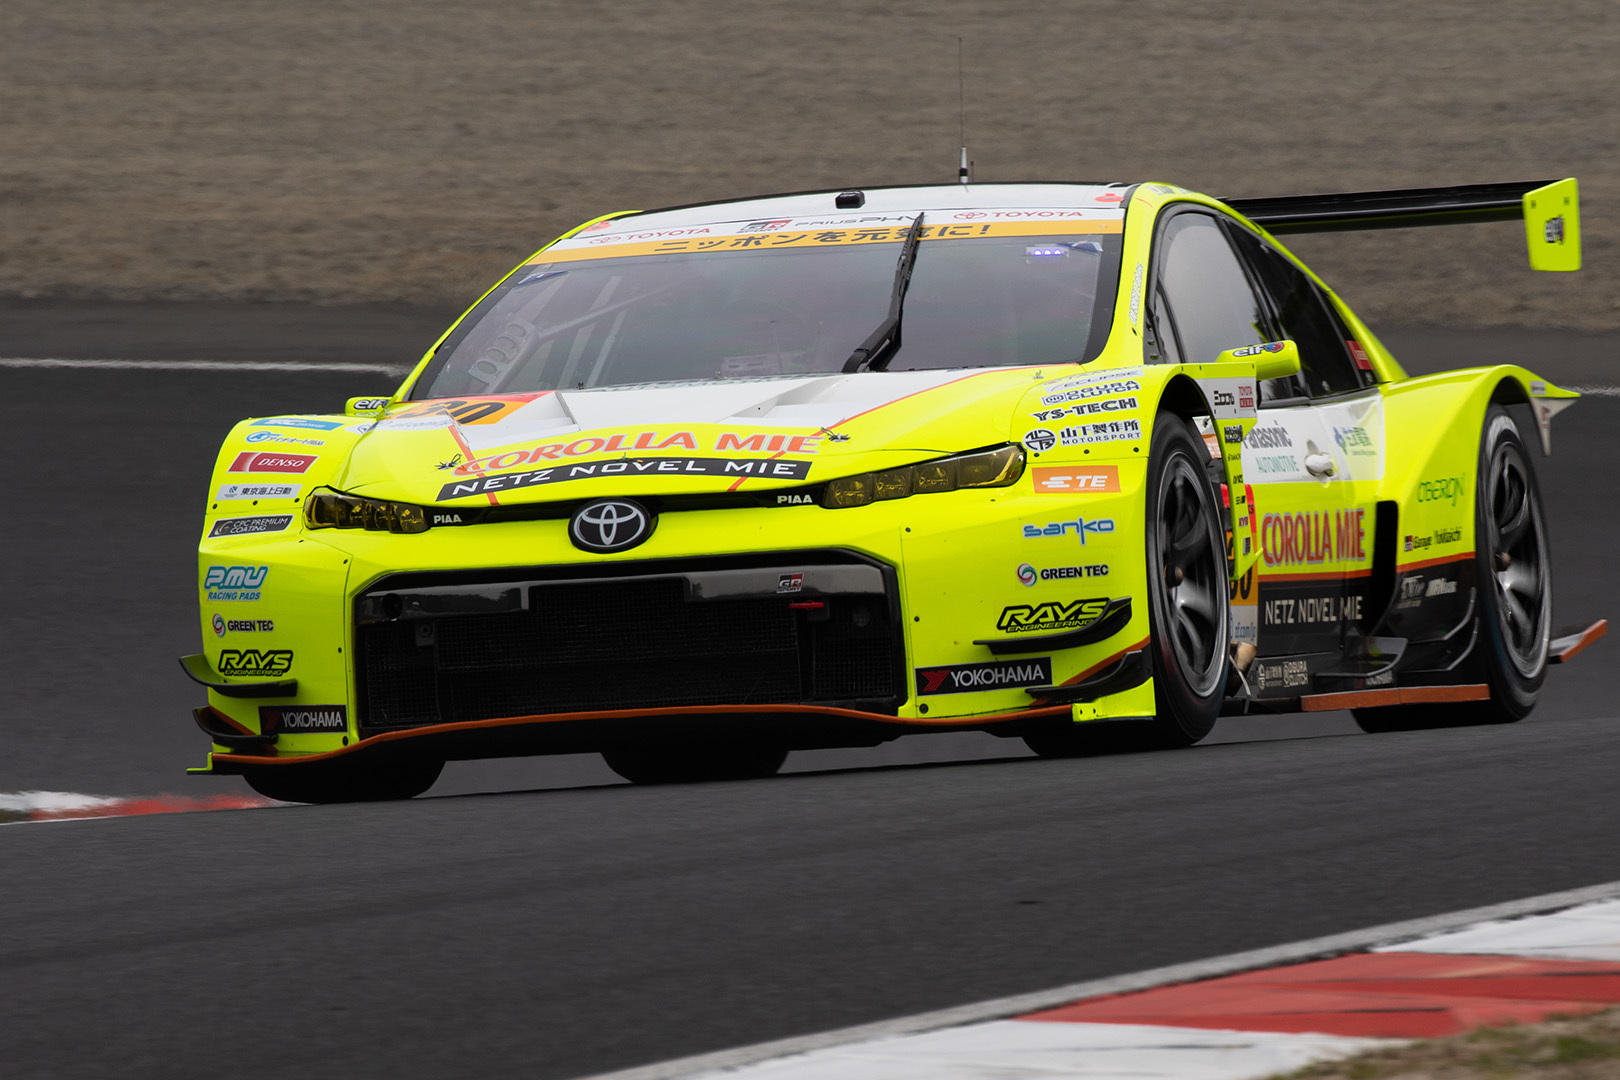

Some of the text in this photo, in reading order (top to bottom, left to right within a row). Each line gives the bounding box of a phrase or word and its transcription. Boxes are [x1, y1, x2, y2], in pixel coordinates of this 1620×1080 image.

[992, 209, 1083, 219] TOYOTA
[627, 226, 711, 241] TOYOTA
[1066, 379, 1138, 396] OGURA
[1067, 384, 1141, 401] CLUTCH
[1032, 397, 1138, 423] YS-TECH
[1062, 432, 1142, 446] MOTORSPORT
[452, 432, 826, 478] COROLLA MIE
[257, 458, 305, 468] DENSO
[452, 460, 798, 496] NETZ NOVEL MIE
[1076, 475, 1108, 488] TE
[777, 494, 814, 505] PIAA
[250, 517, 289, 527] PREMIUM
[433, 513, 463, 525] PIAA
[230, 524, 267, 534] COATING
[1262, 508, 1366, 567] COROLLA MIE
[1040, 564, 1110, 581] GREEN TEC
[207, 591, 261, 601] RACING PADS
[1000, 599, 1109, 628] RAYS
[1264, 595, 1364, 626] NETZ NOVEL MIE
[227, 620, 274, 632] GREEN TEC
[1006, 618, 1096, 633] ENGINEERING
[219, 650, 293, 671] RAYS
[223, 668, 284, 677] ENGINEERING
[951, 663, 1046, 687] YOKOHAMA
[281, 711, 344, 728] YOKOHAMA
